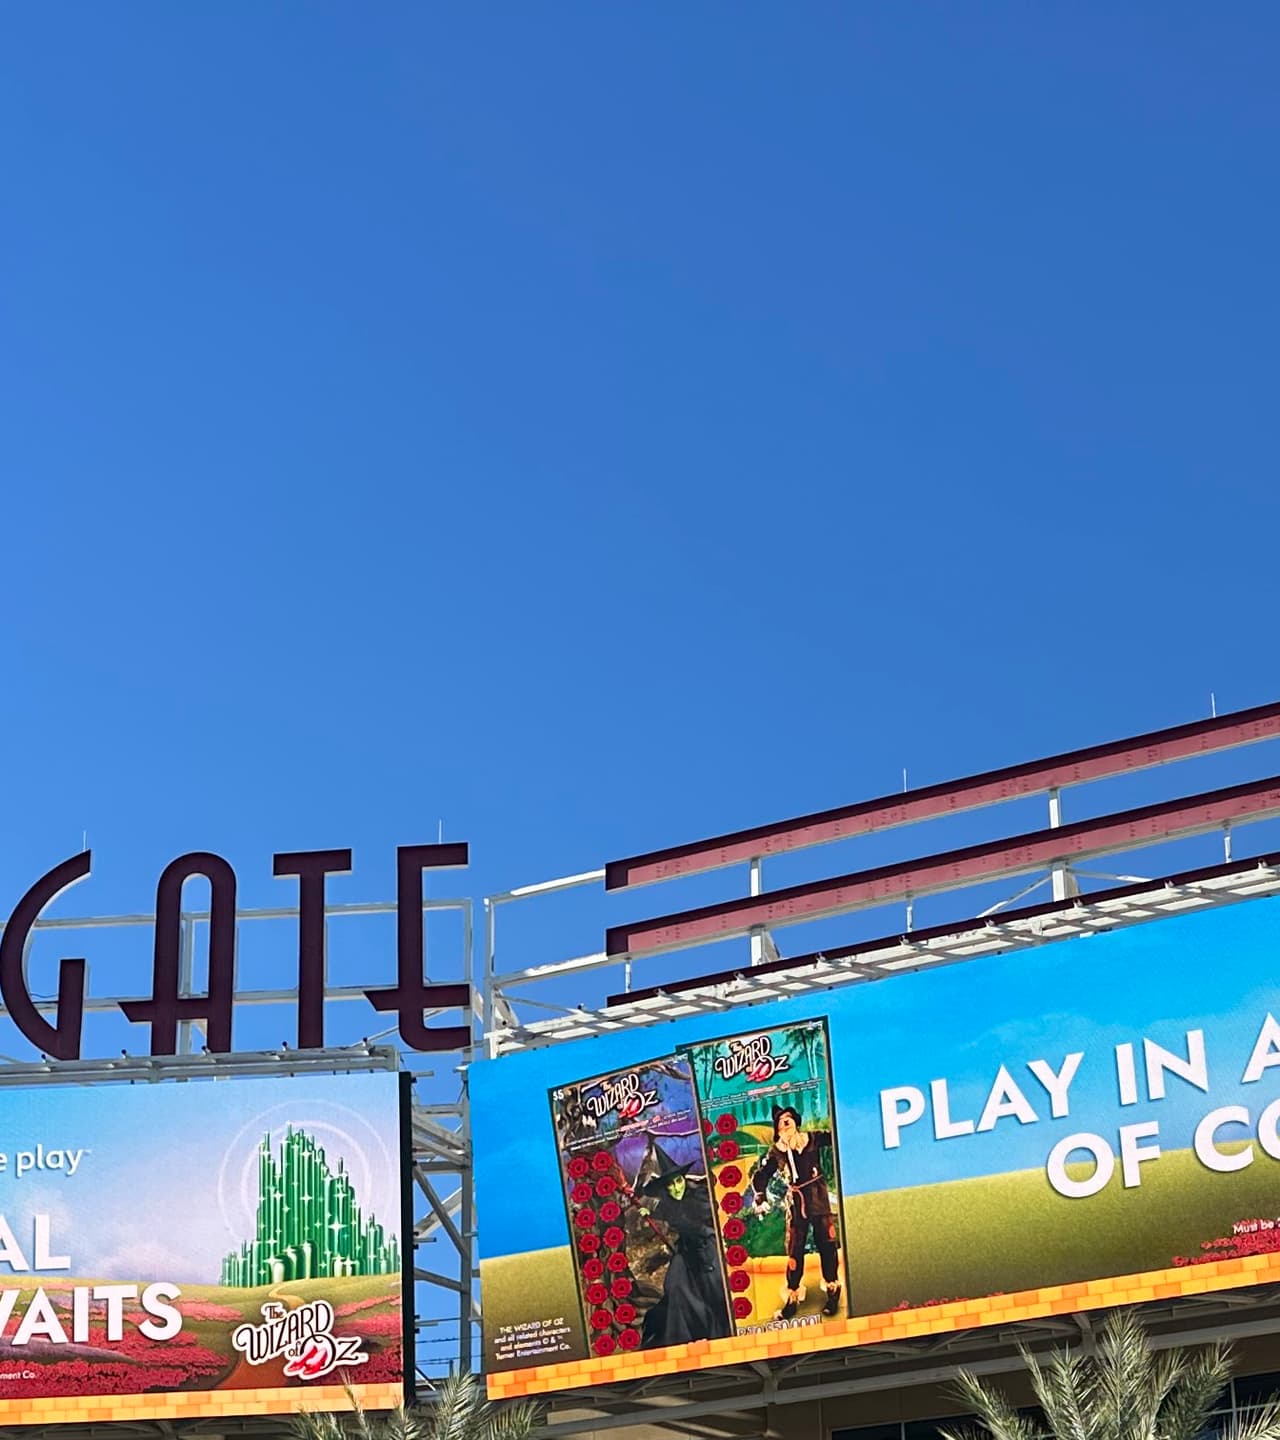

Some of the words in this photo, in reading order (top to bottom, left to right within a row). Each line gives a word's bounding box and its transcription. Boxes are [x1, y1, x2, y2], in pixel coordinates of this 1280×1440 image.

[715, 1037, 770, 1078] WIZARD
[552, 1090, 564, 1100] $5
[587, 1074, 639, 1116] WIZARD
[879, 1051, 1084, 1150] PLAY
[1116, 1028, 1209, 1106] IN
[16, 1143, 82, 1178] play
[1045, 1121, 1162, 1199] OF
[1232, 1223, 1259, 1234] Must
[1260, 1219, 1274, 1229] be
[264, 1305, 286, 1319] The
[236, 1303, 331, 1361] WIZARD
[288, 1341, 300, 1357] of
